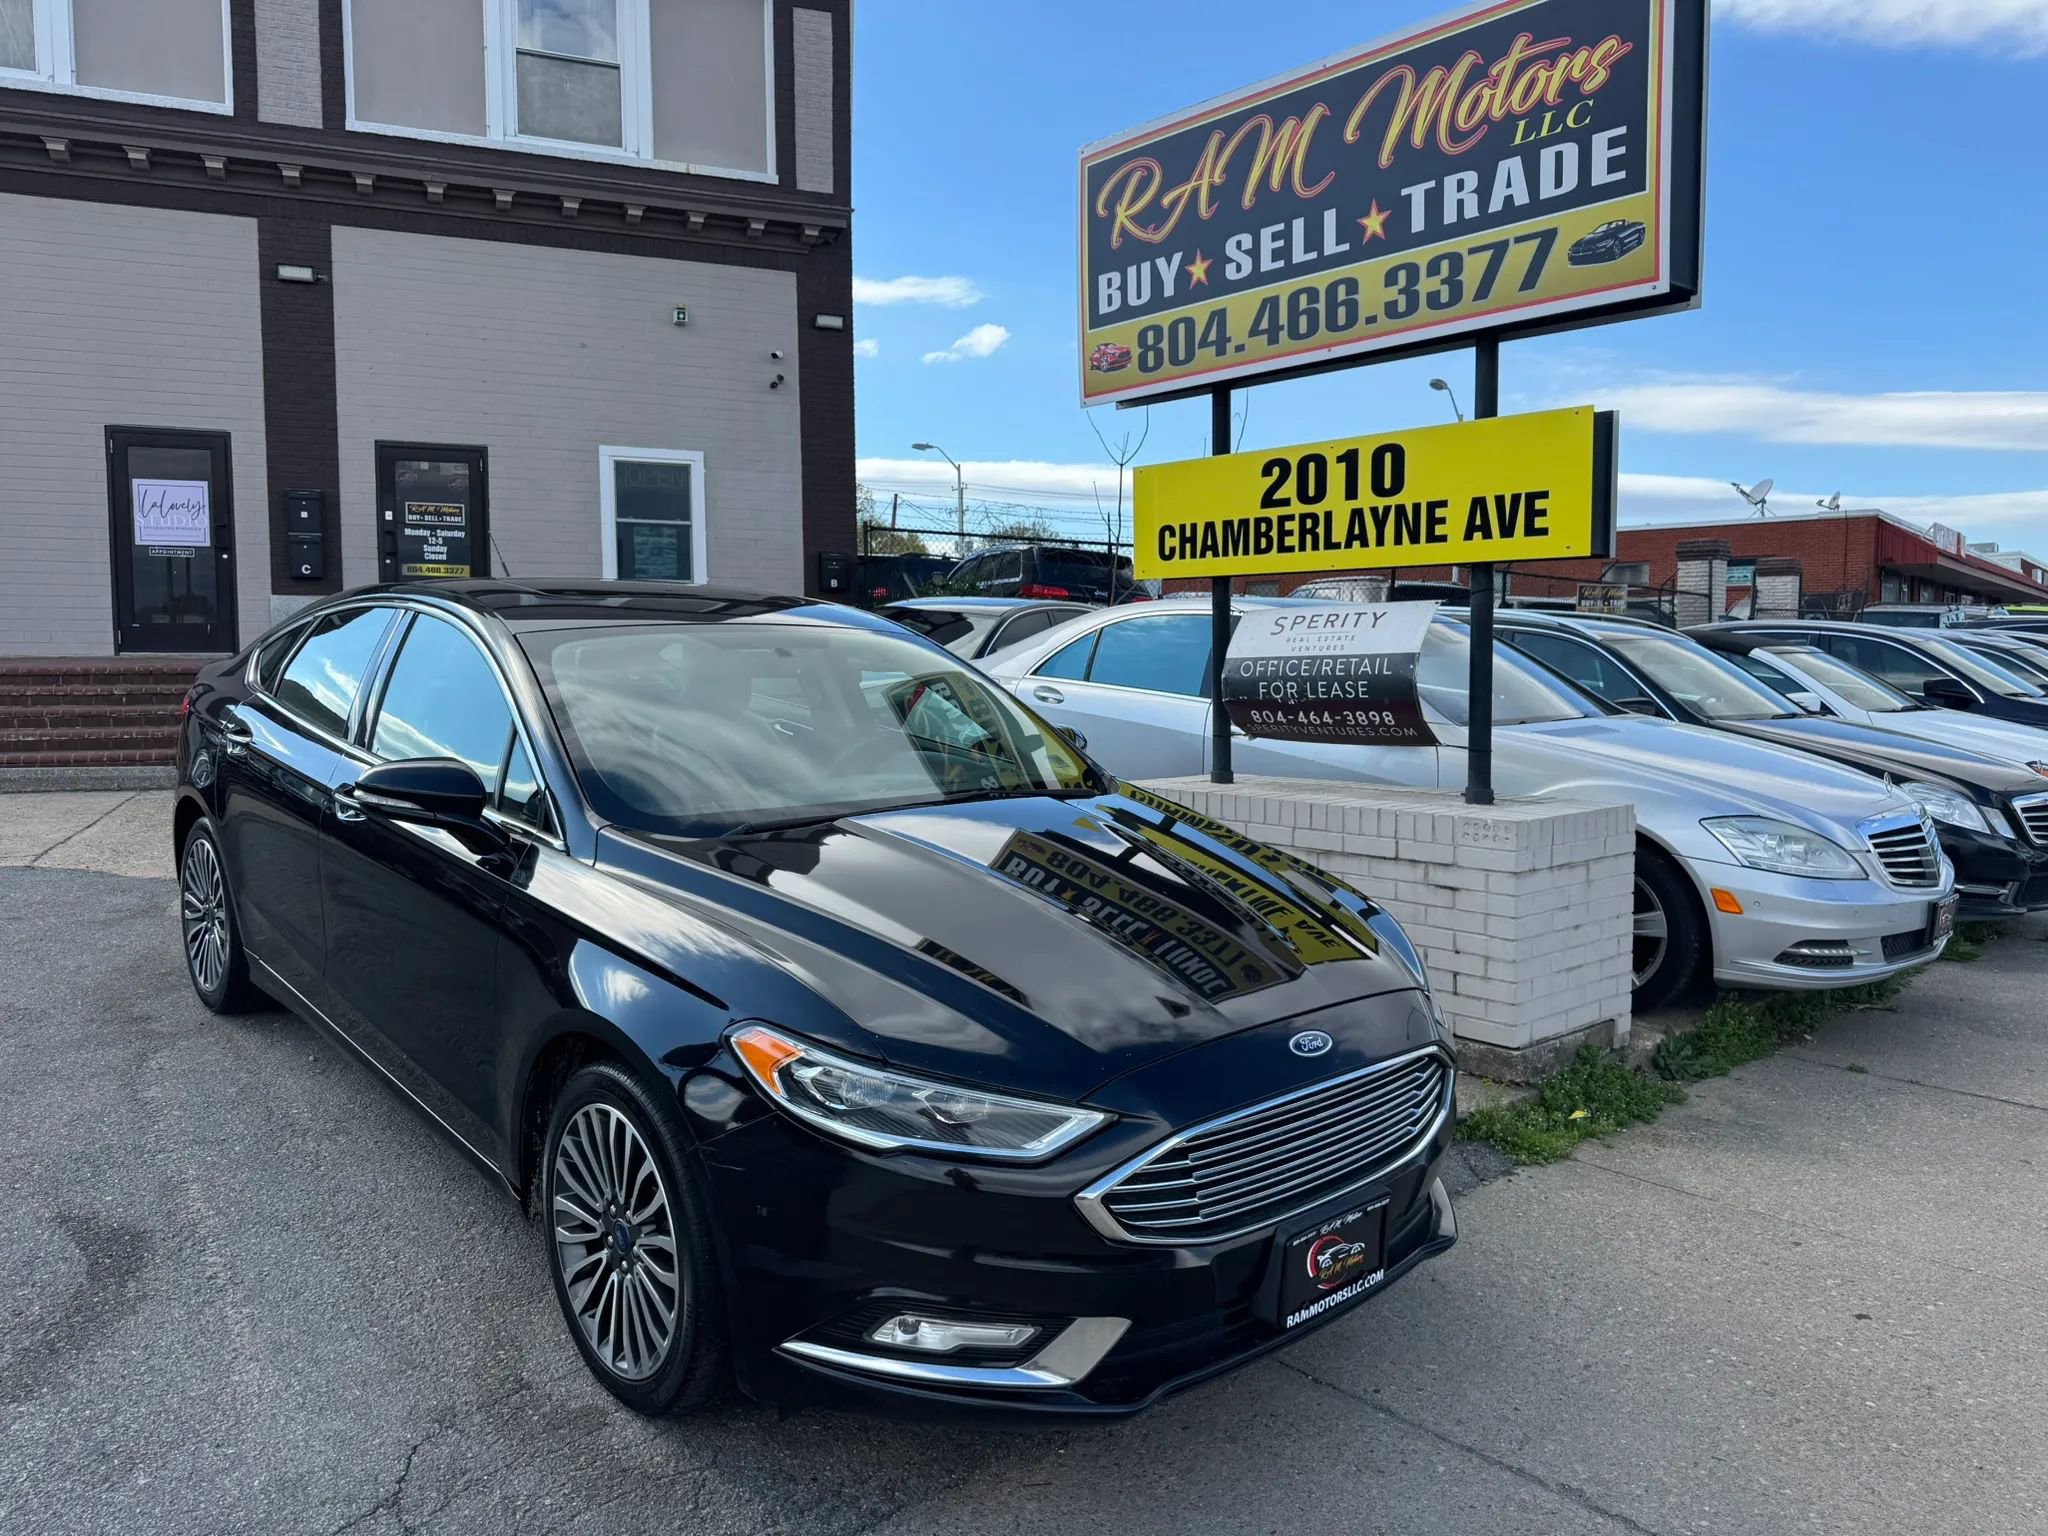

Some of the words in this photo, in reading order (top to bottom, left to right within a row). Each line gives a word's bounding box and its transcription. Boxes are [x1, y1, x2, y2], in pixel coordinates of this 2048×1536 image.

[1510, 99, 1594, 147] LLC
[1096, 103, 1335, 249] RAM
[1344, 32, 1633, 169] Motors
[1098, 251, 1184, 315] BUY
[1225, 208, 1351, 281] SELL
[1401, 126, 1628, 234] TRADE
[1137, 227, 1559, 374] 804.466.3377
[1260, 443, 1406, 509] 2010
[404, 528, 431, 536] Monday
[437, 529, 465, 538] Saturday
[1158, 499, 1449, 562] CHAMBERLAYNE
[1463, 490, 1550, 543] AVE
[423, 545, 447, 553] Sunday
[428, 537, 443, 545] 12-5
[301, 564, 311, 574] C
[830, 578, 838, 588] B
[1270, 611, 1388, 636] SPERITY
[1291, 644, 1345, 652] VENTURES
[1240, 657, 1393, 677] OFFICE/RETAIL
[1259, 681, 1299, 699] FOR
[1307, 681, 1369, 699] LEASE
[1250, 710, 1396, 726] 804-464-3898
[1247, 723, 1418, 737] SPERITYVENTURES.COM
[1299, 1036, 1324, 1052] Ford
